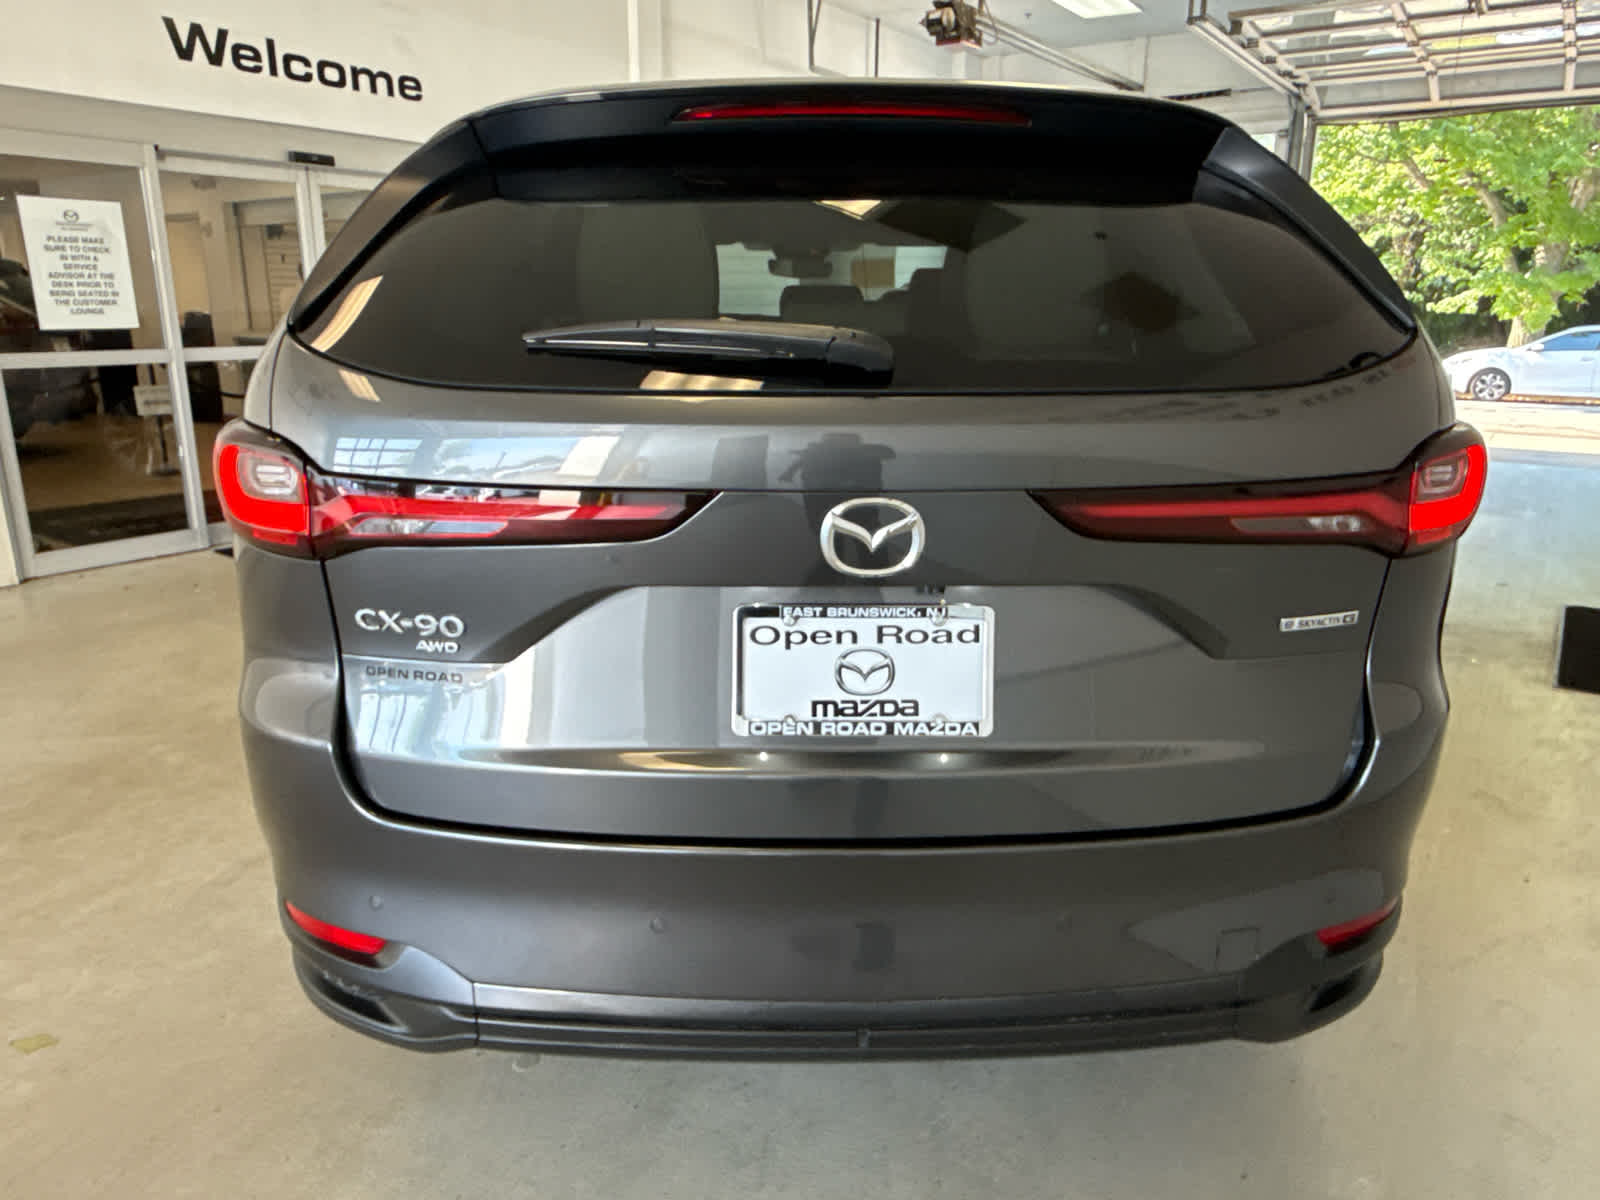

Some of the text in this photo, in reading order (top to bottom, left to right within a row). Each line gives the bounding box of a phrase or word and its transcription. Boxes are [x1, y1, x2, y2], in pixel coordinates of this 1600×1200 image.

[161, 16, 424, 102] Welcome
[46, 235, 105, 244] PLEASE MAKE
[43, 244, 110, 254] SURE TO CHECK
[70, 254, 91, 262] WITH
[63, 263, 98, 271] SERVICE
[48, 271, 115, 280] ADVISOR AT THE
[51, 280, 115, 289] DESK PRIOR TO
[49, 289, 75, 297] BEING
[77, 290, 109, 298] SEATED
[55, 298, 118, 306] THE CUSTOMER
[783, 606, 947, 618] EAST BRUNSWICK, NJ
[354, 607, 465, 639] CX-90
[750, 624, 981, 650] Open Road
[415, 639, 459, 653] AWD
[365, 665, 464, 684] OPEN ROAD
[750, 721, 978, 736] OPEN ROAD MAZDA
